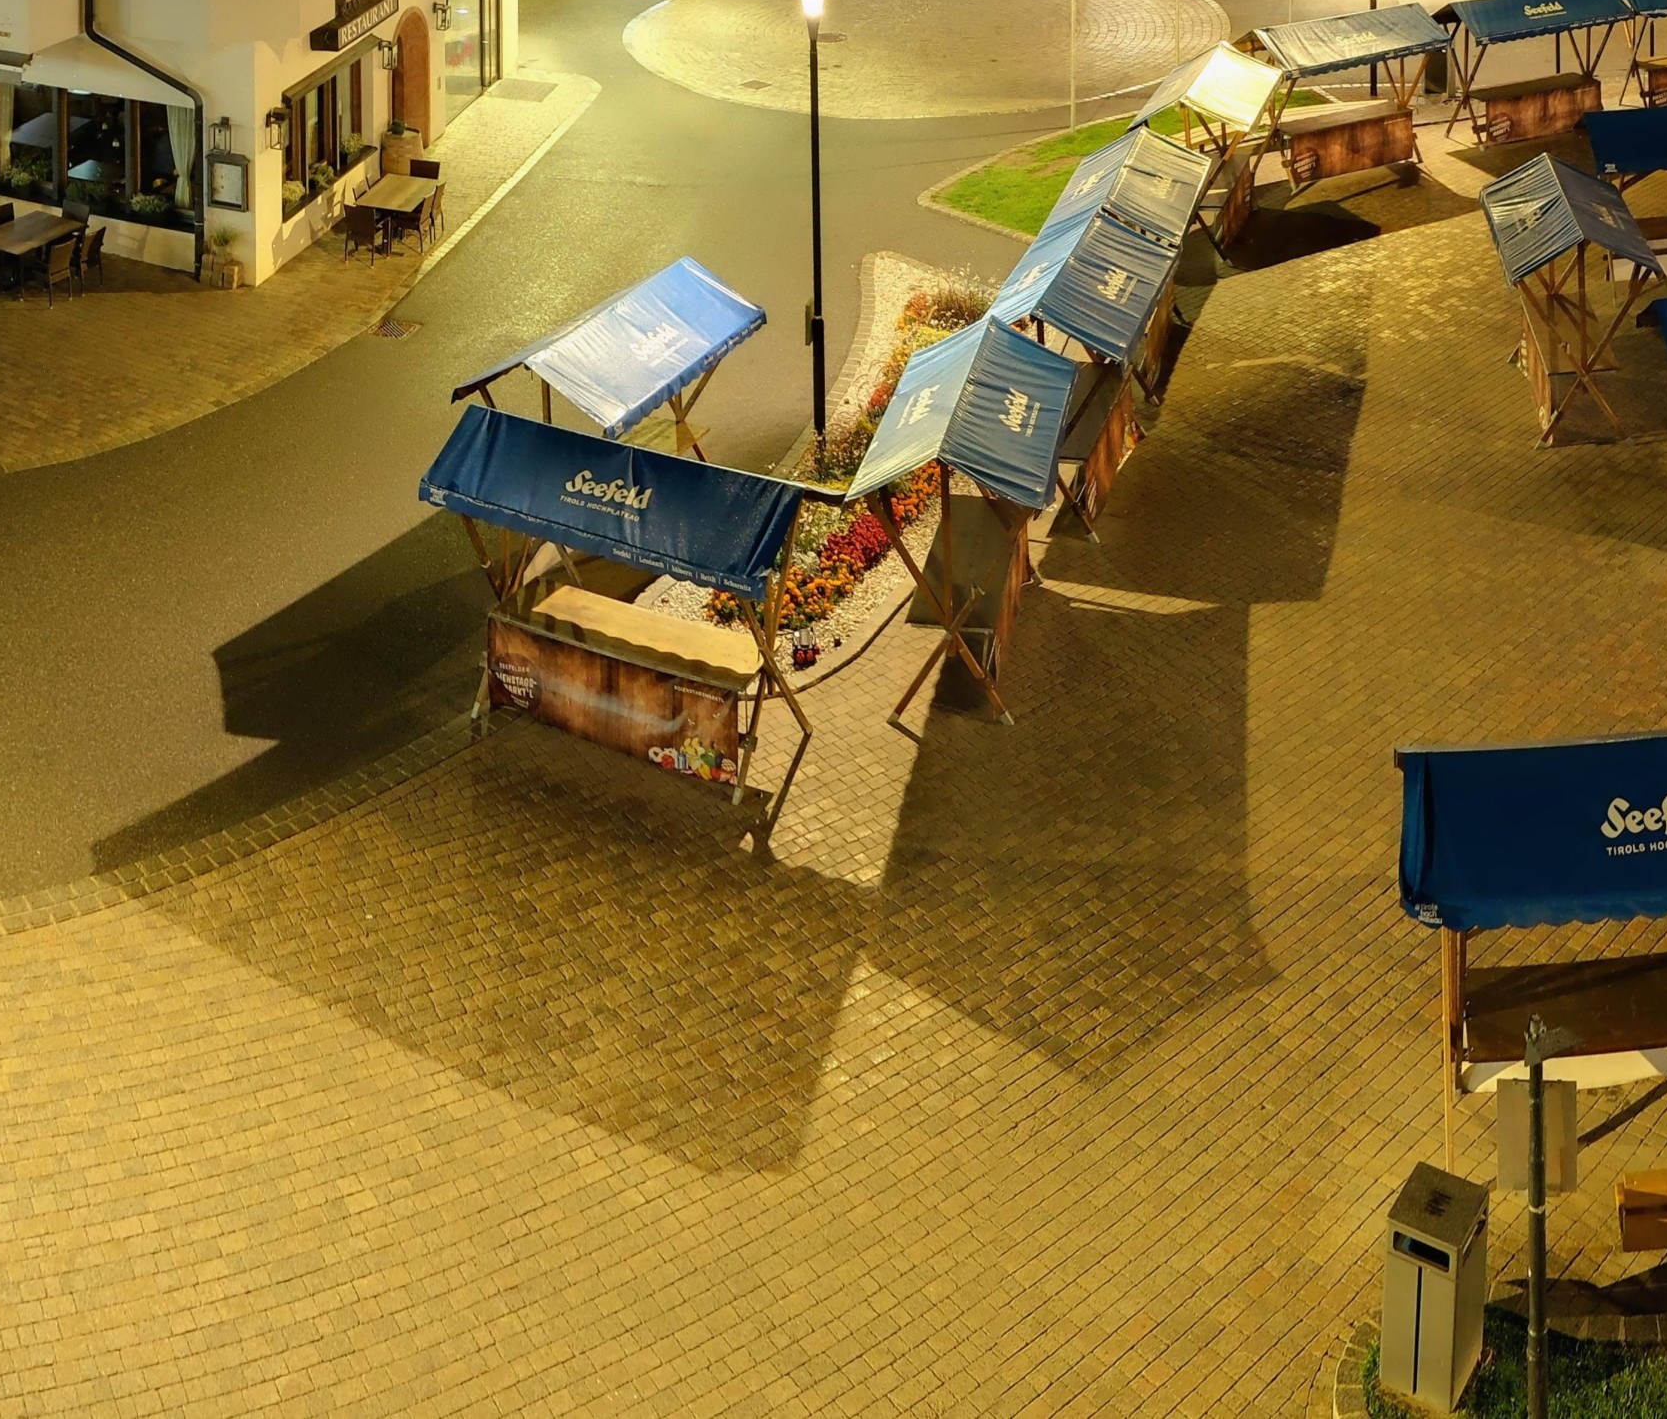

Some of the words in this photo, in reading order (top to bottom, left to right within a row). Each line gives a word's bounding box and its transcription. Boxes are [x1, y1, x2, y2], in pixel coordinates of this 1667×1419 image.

[1523, 1, 1564, 16] Seefeld
[565, 468, 653, 511] Seefeld
[559, 495, 586, 509] TIROLS
[587, 501, 640, 523] HOCHPLATEAU
[1606, 843, 1646, 857] TIROLS
